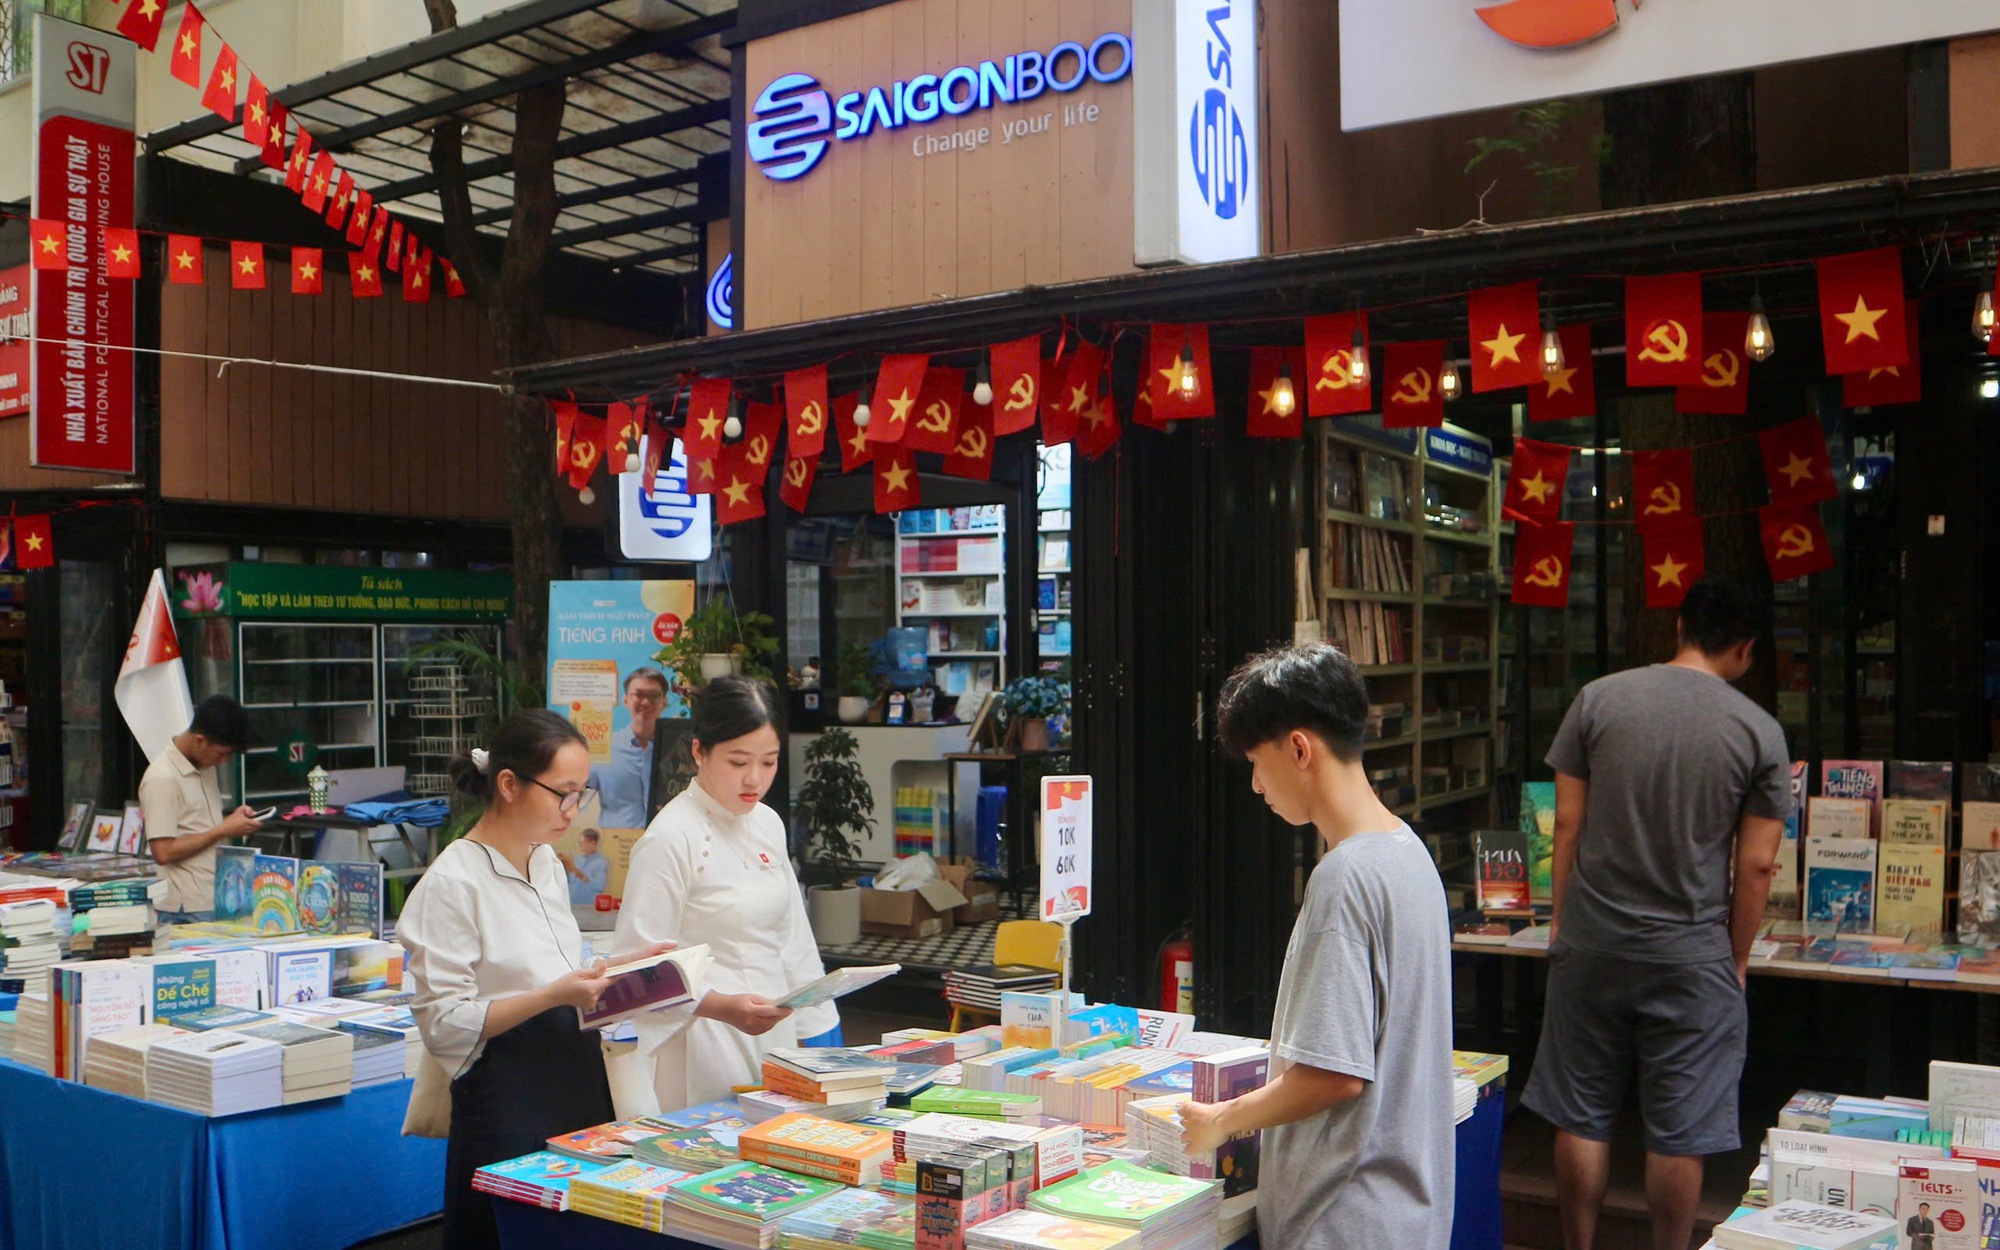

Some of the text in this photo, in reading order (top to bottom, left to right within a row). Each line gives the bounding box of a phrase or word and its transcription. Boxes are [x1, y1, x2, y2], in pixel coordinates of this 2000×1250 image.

[65, 41, 110, 95] ST
[836, 31, 1133, 140] SAIGONBOO
[913, 102, 1099, 157] Change your life
[98, 143, 111, 195] HOUSE
[60, 134, 92, 442] NHÀ XUẤT BẢN CHÍNH TRỊ QUỐC GIA SỰ THẬT
[96, 290, 110, 365] POLITICAL
[96, 370, 109, 444] NATIONAL
[377, 577, 403, 590] sách
[262, 592, 278, 609] TẬP
[280, 592, 291, 607] VÀ
[293, 592, 312, 608] LÀM
[313, 595, 334, 608] THEO
[558, 622, 646, 643] TIẾNG ANH
[289, 742, 306, 762] ST
[1058, 826, 1076, 846] 10K
[1056, 855, 1076, 874] 60K
[1817, 849, 1868, 860] FORWARD
[157, 975, 185, 986] Những
[157, 981, 210, 1001] Đế Chế
[157, 997, 210, 1010] công nghệ số
[1921, 1182, 1953, 1194] IELTS
